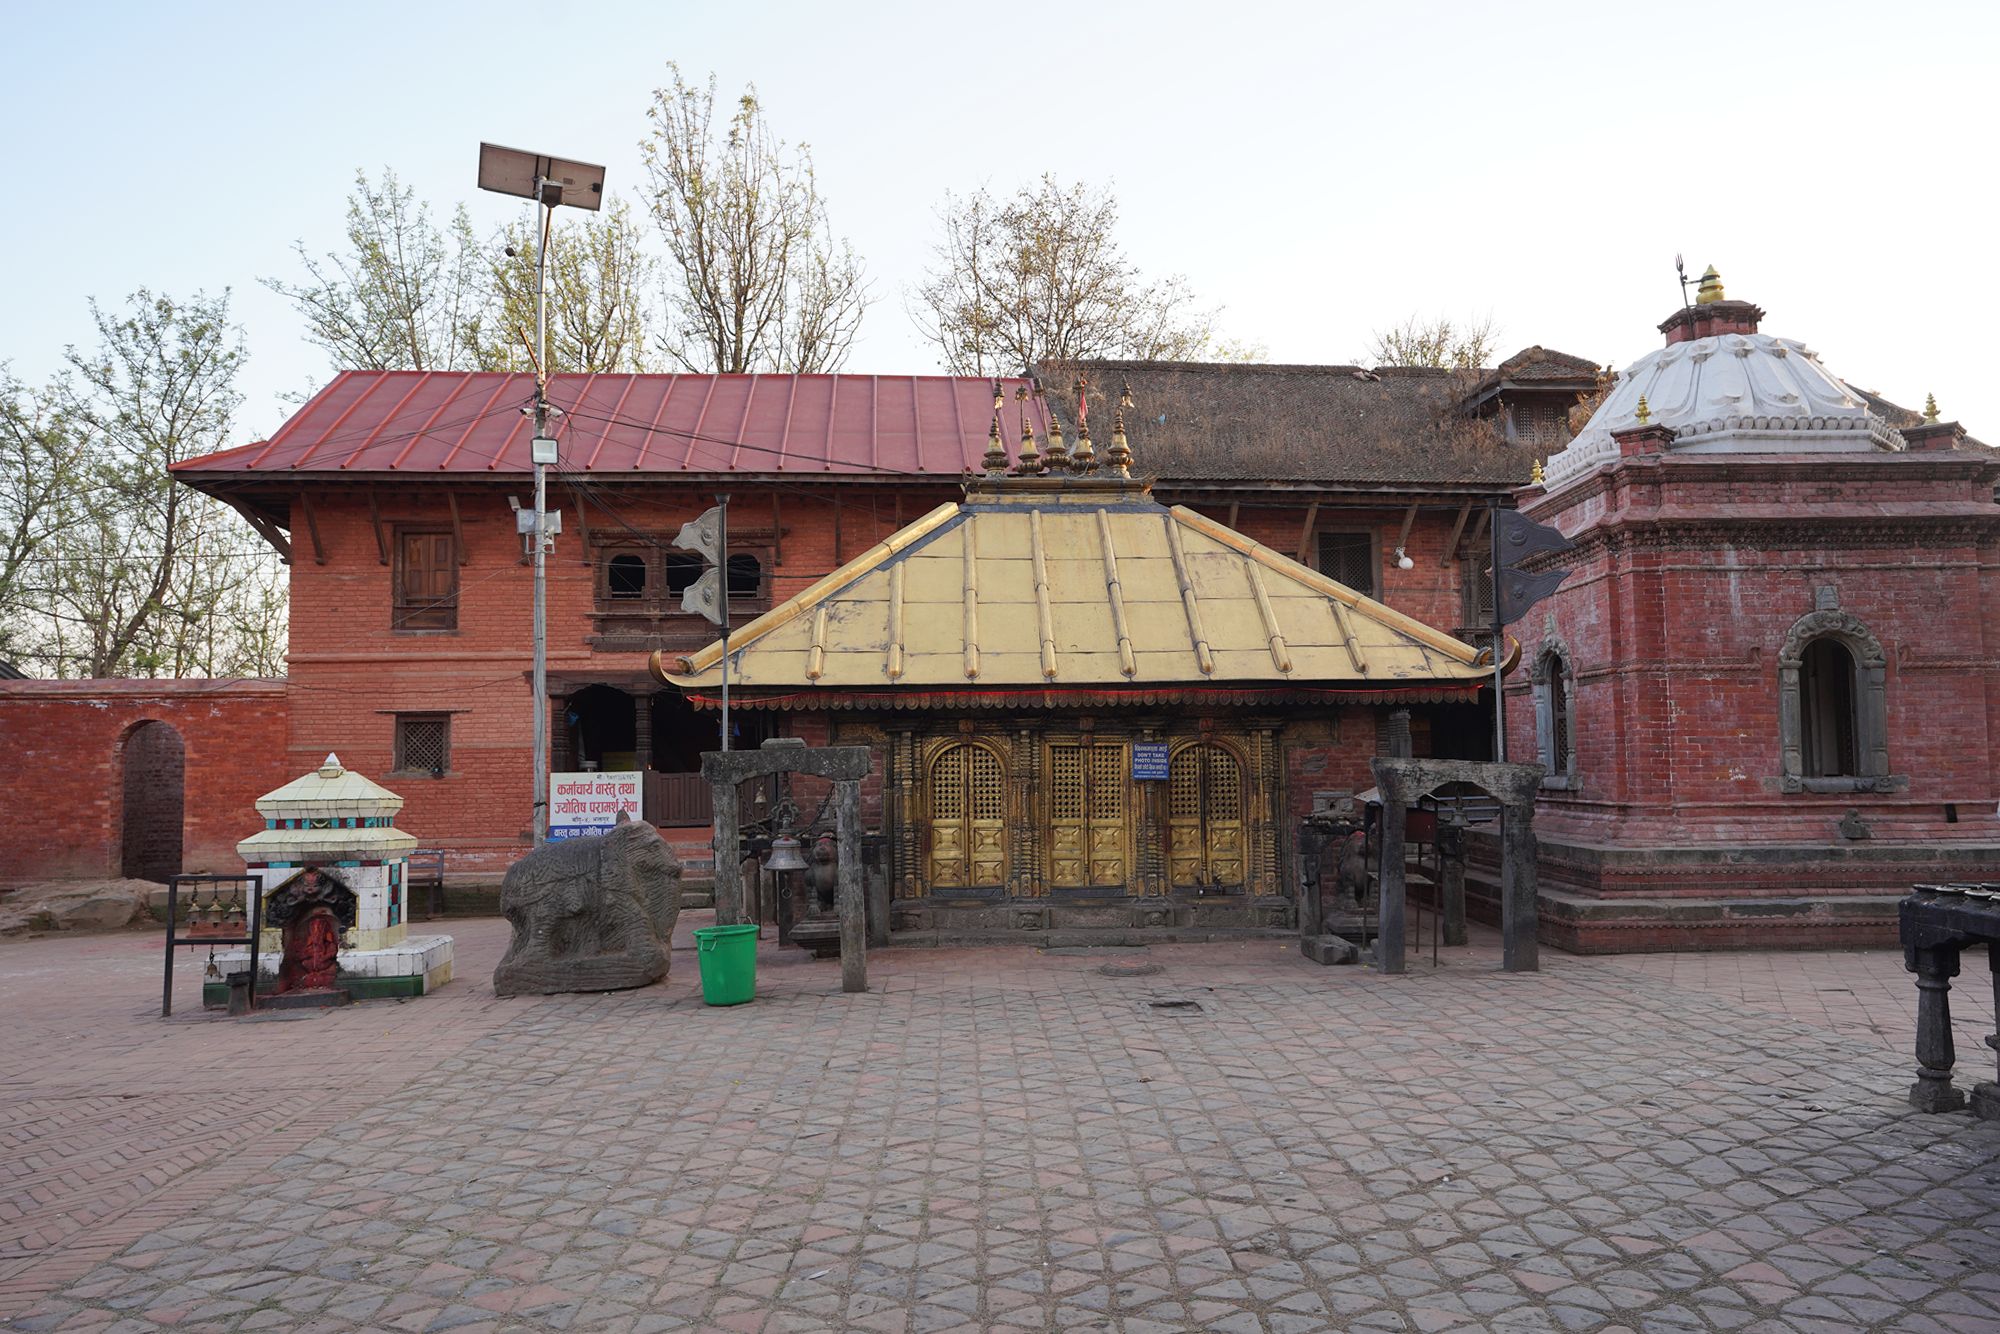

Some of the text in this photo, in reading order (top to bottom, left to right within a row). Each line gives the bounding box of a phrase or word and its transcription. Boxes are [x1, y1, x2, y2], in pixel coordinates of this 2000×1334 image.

[557, 780, 635, 798] कर्माचार्य वास्तु तथा
[554, 798, 638, 814] ज्योतिष परामर्श सेवा
